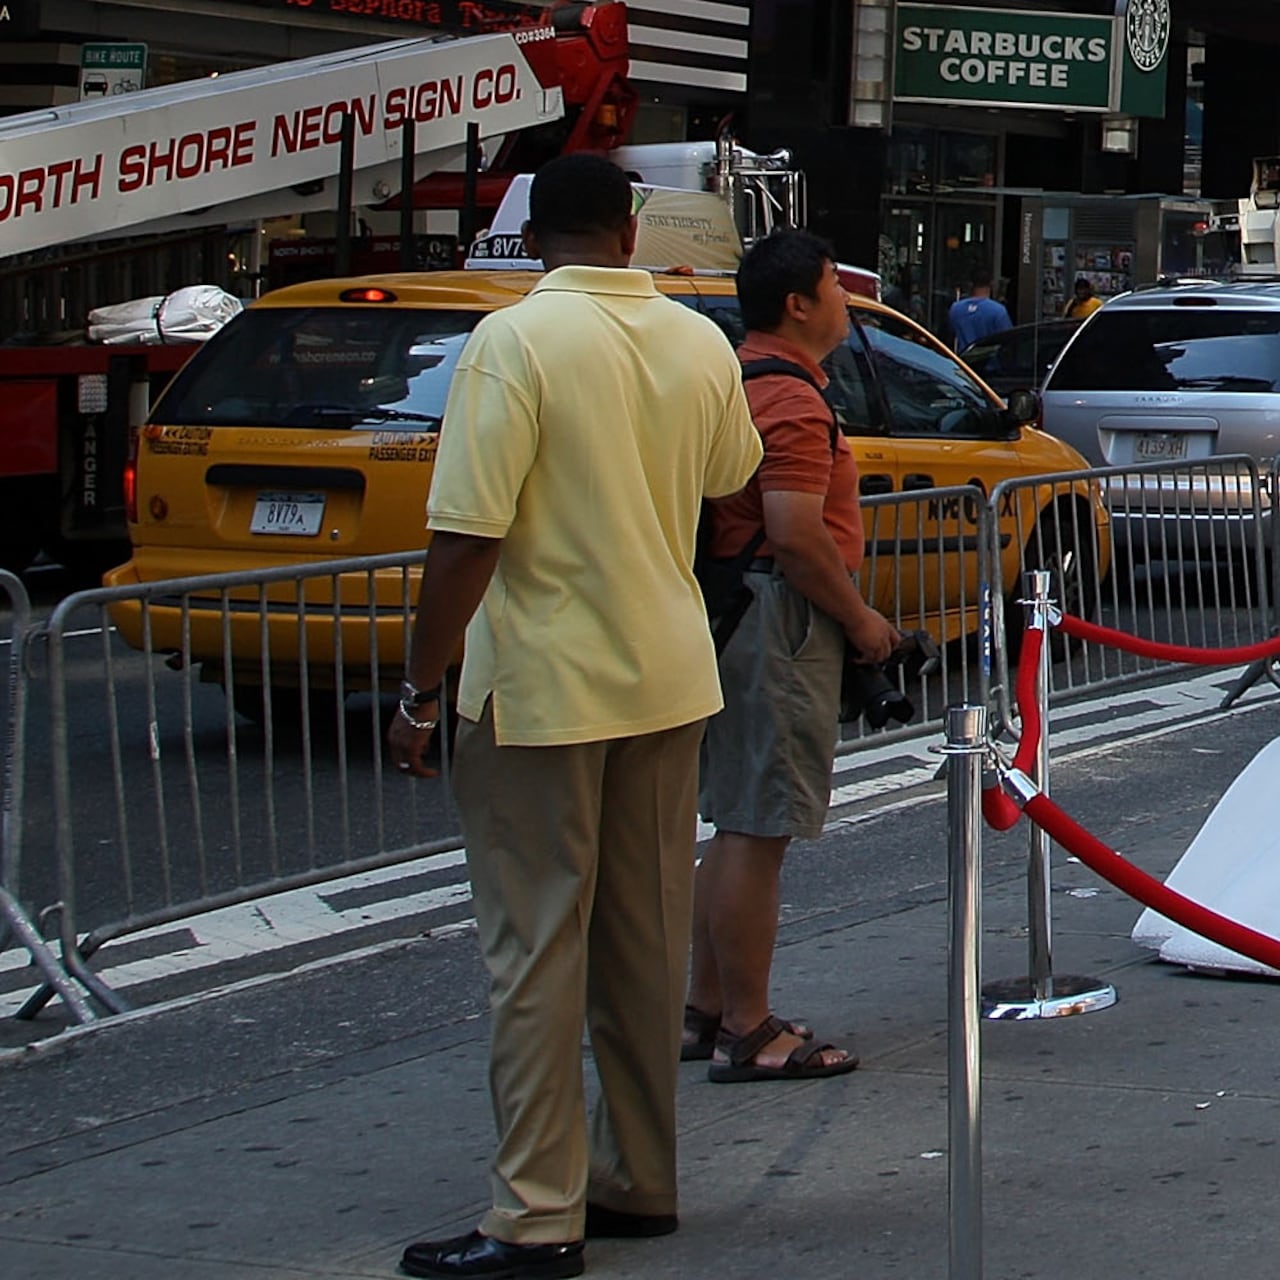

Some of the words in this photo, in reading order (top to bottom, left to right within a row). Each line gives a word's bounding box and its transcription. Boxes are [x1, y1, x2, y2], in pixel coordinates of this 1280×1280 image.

[85, 49, 107, 64] BIKE
[109, 49, 142, 64] ROUTE
[902, 26, 1107, 63] STARBUCKS
[1131, 37, 1162, 67] COFFEE
[939, 57, 1069, 89] COFFEE
[117, 121, 258, 192] SHORE
[270, 94, 376, 158] NEON
[384, 74, 464, 124] SIGN
[472, 63, 522, 109] CO.
[372, 431, 416, 446] CAUTION
[83, 422, 97, 506] ANGER
[369, 447, 417, 462] PASSENGER
